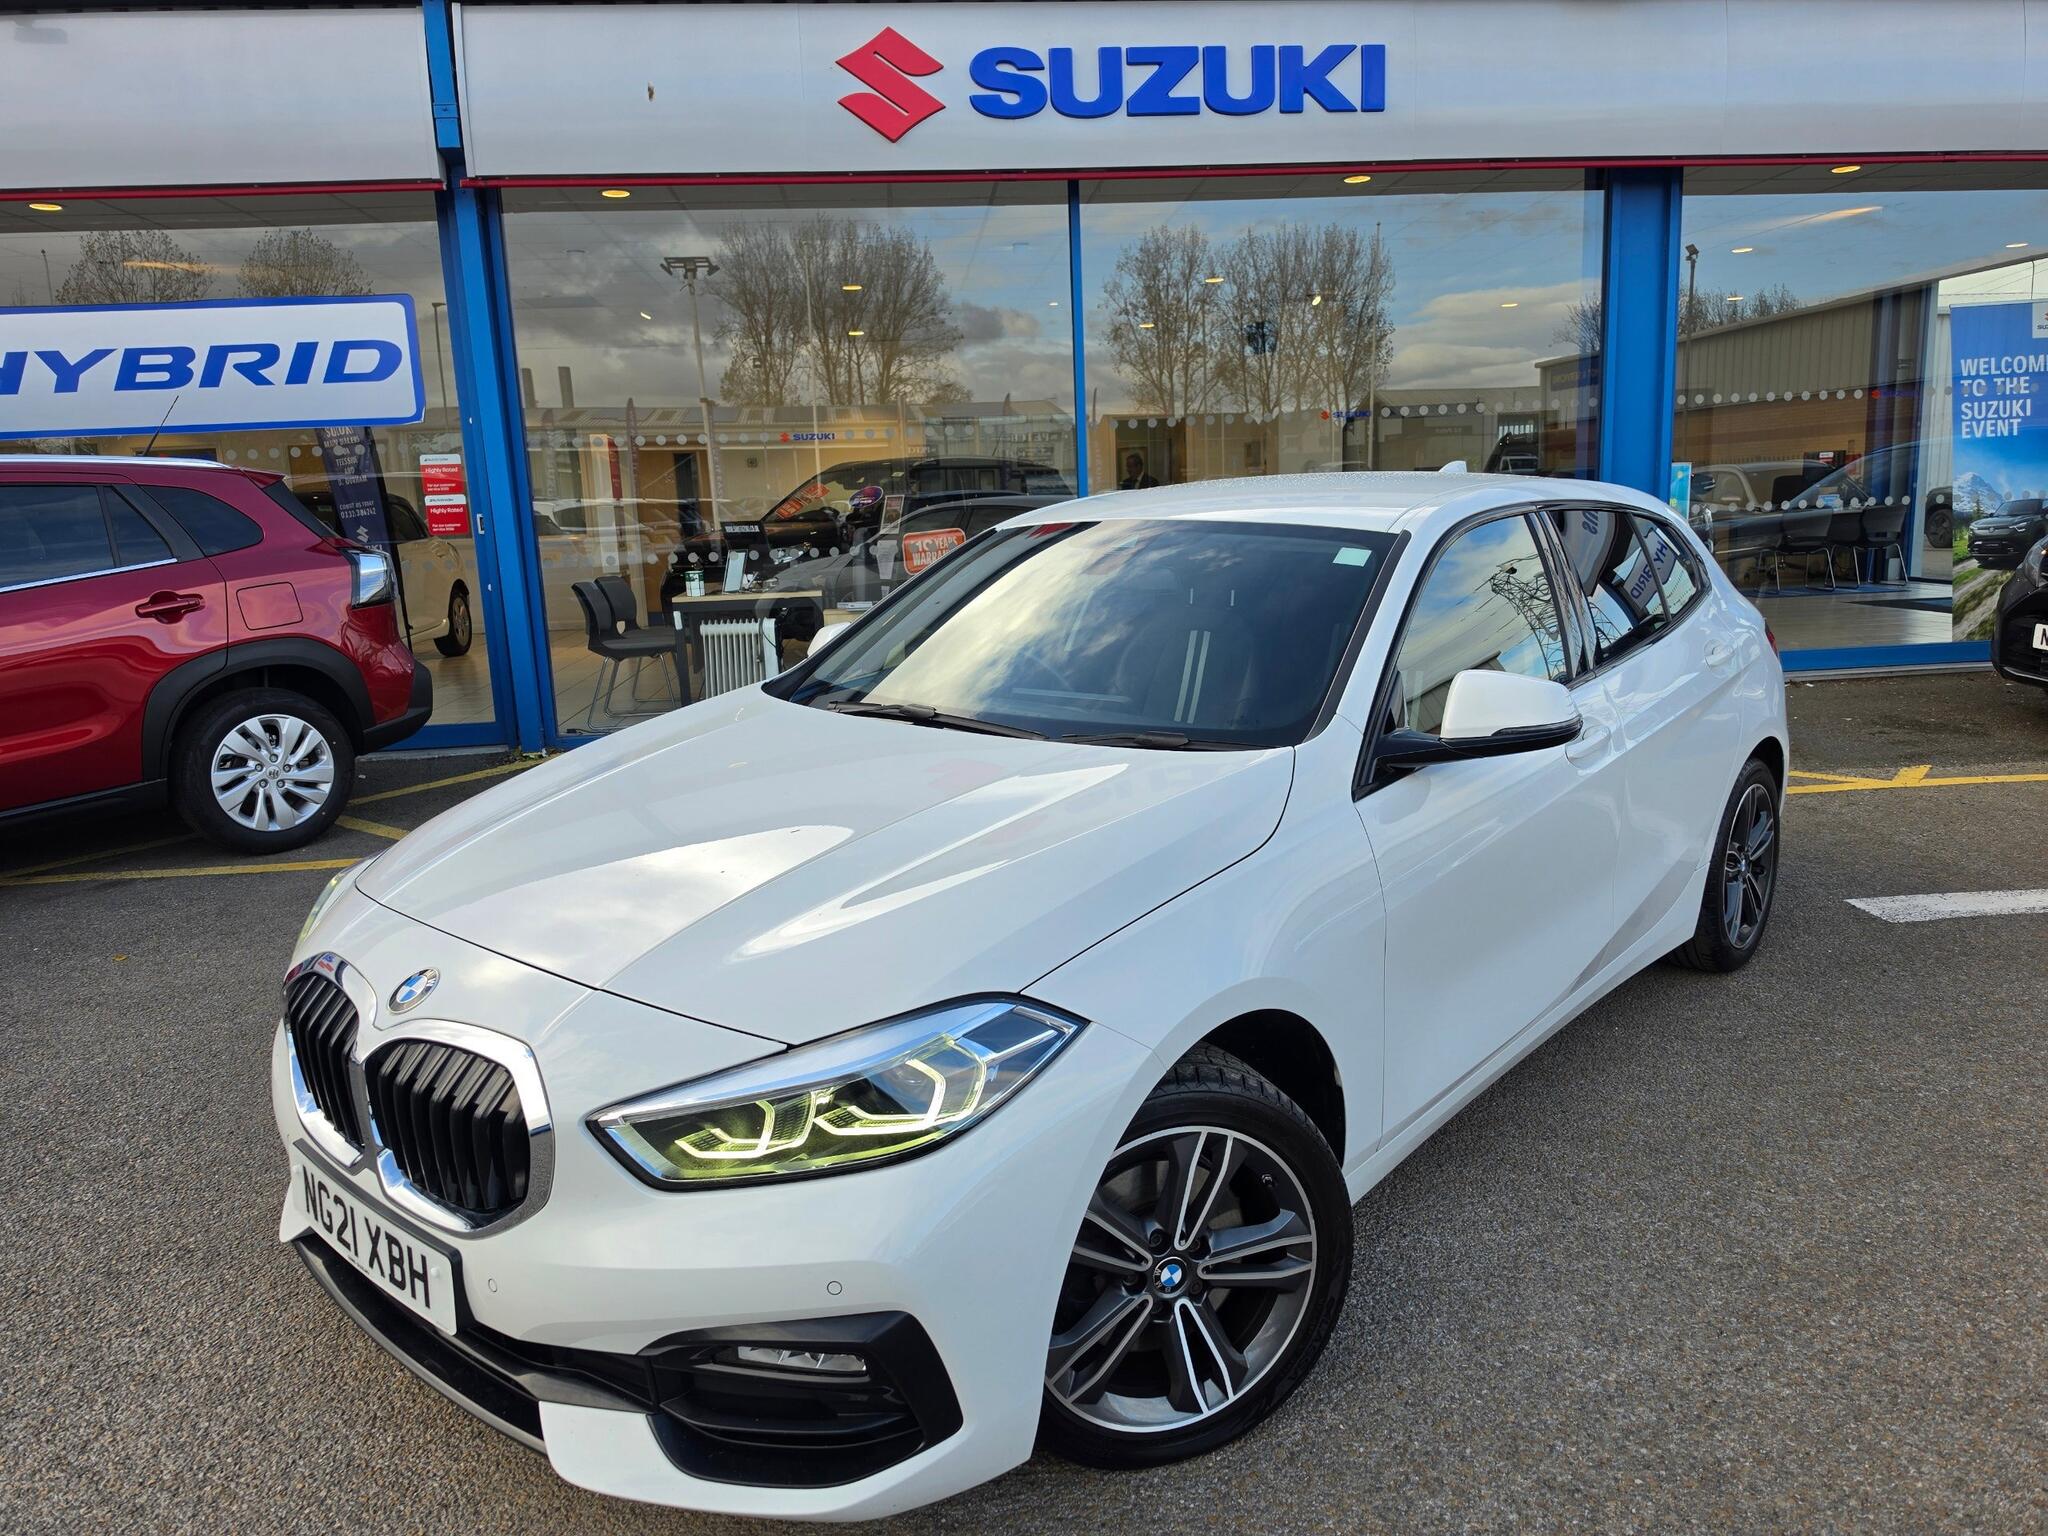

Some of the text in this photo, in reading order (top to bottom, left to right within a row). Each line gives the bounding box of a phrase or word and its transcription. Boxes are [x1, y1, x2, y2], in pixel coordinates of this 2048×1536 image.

[969, 44, 1386, 119] SUZUKI
[1960, 354, 2048, 377] WELCOM
[1960, 376, 2030, 397] TO THE
[1961, 399, 2031, 420] SUZUKI
[792, 432, 835, 441] SUZUKI
[1961, 419, 2022, 439] EVENT
[430, 507, 447, 515] Highly
[303, 1165, 431, 1310] NG21 XBH
